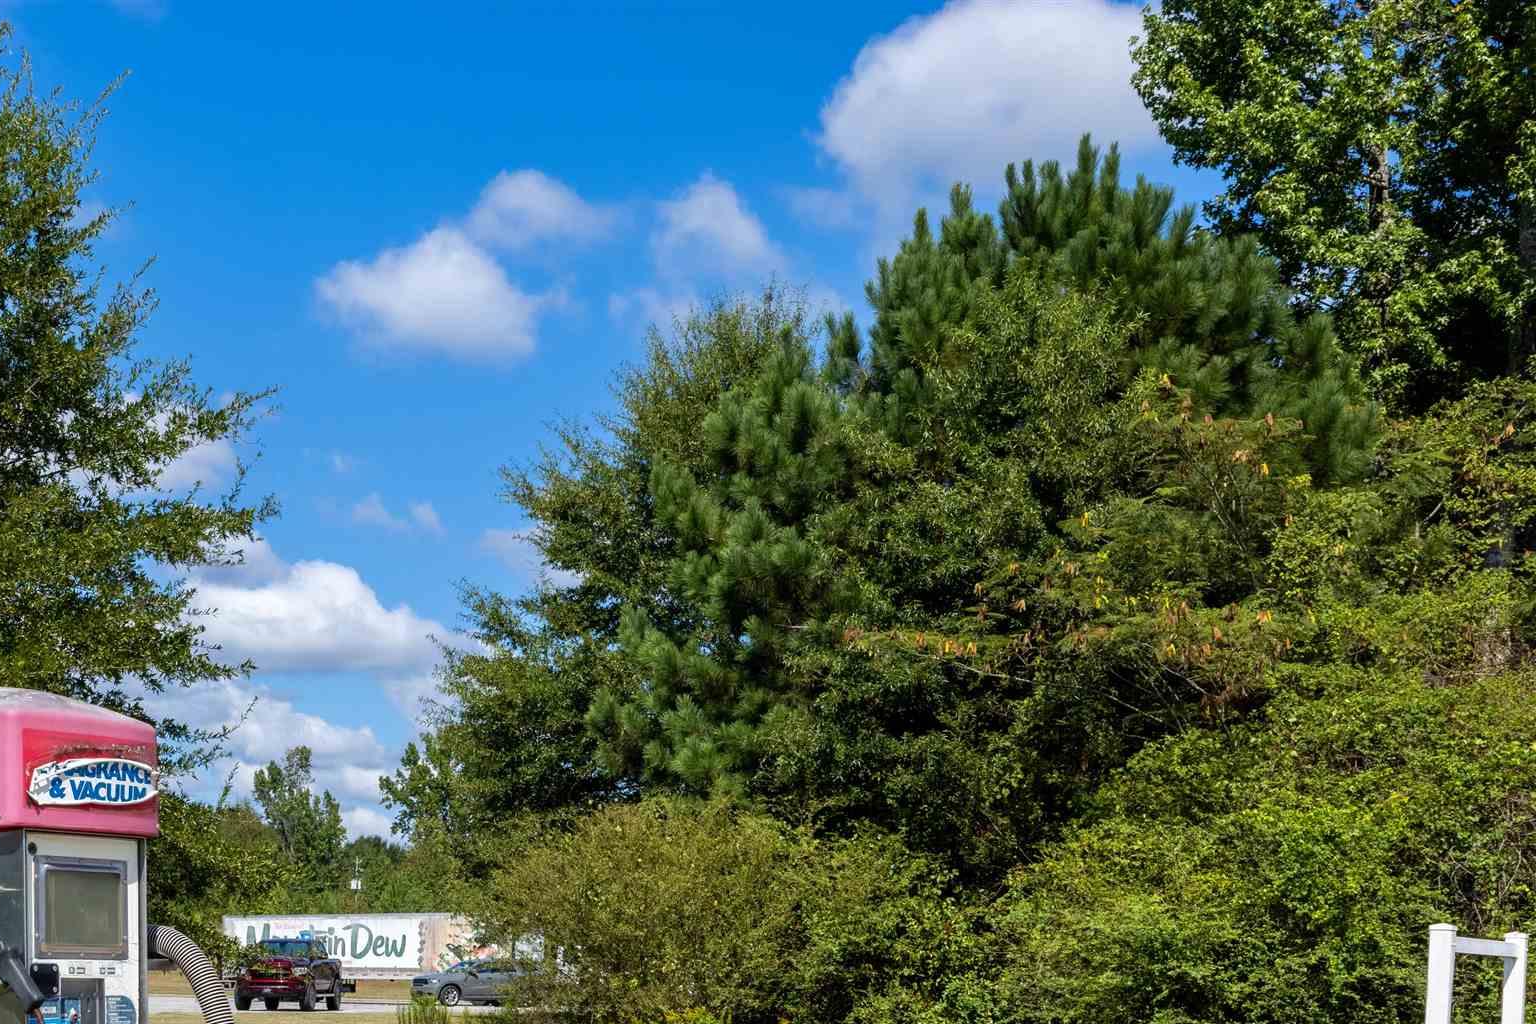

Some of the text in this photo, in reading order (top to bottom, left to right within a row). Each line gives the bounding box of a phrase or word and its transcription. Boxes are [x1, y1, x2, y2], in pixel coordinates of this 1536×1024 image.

[42, 761, 151, 784] AGRANCE
[49, 777, 146, 802] & VACUUM
[342, 923, 406, 959] Dew
